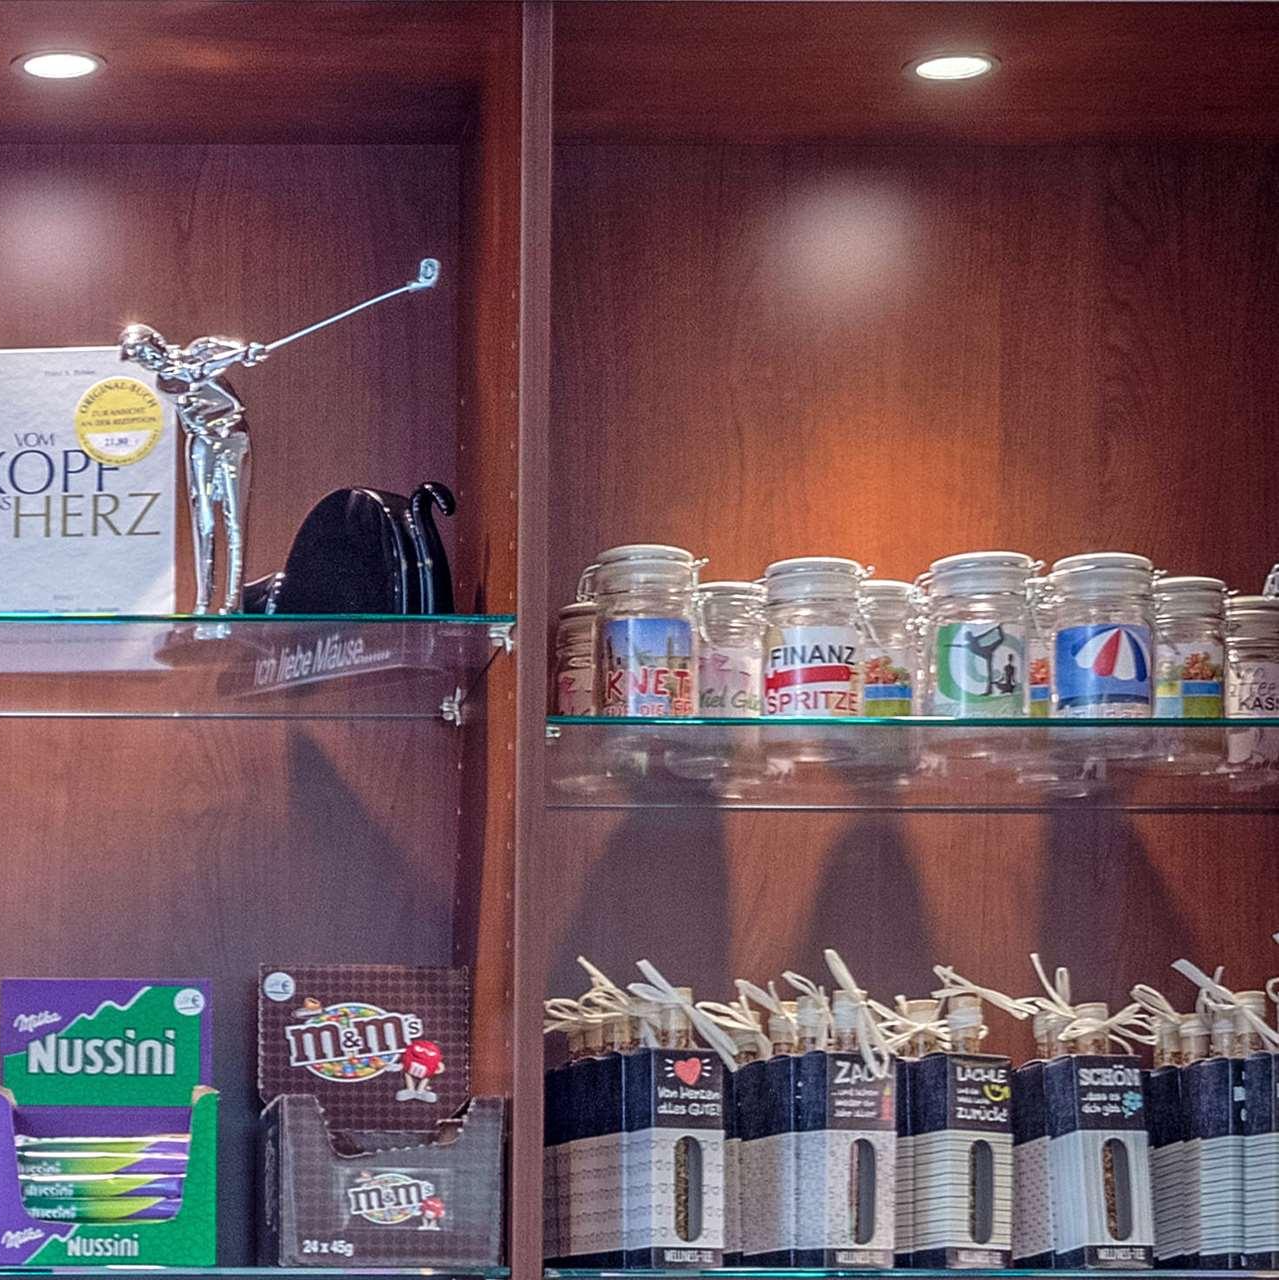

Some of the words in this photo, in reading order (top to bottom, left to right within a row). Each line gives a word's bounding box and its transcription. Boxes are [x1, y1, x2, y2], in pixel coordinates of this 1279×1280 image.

[15, 433, 55, 447] VOM
[14, 493, 160, 538] HERZ
[771, 646, 856, 668] FINANZ
[768, 691, 857, 714] SPRITZE
[13, 1011, 61, 1032] Milka
[1079, 1064, 1140, 1086] SCHÖN
[1, 1228, 45, 1249] Milka
[303, 1240, 319, 1253] 24
